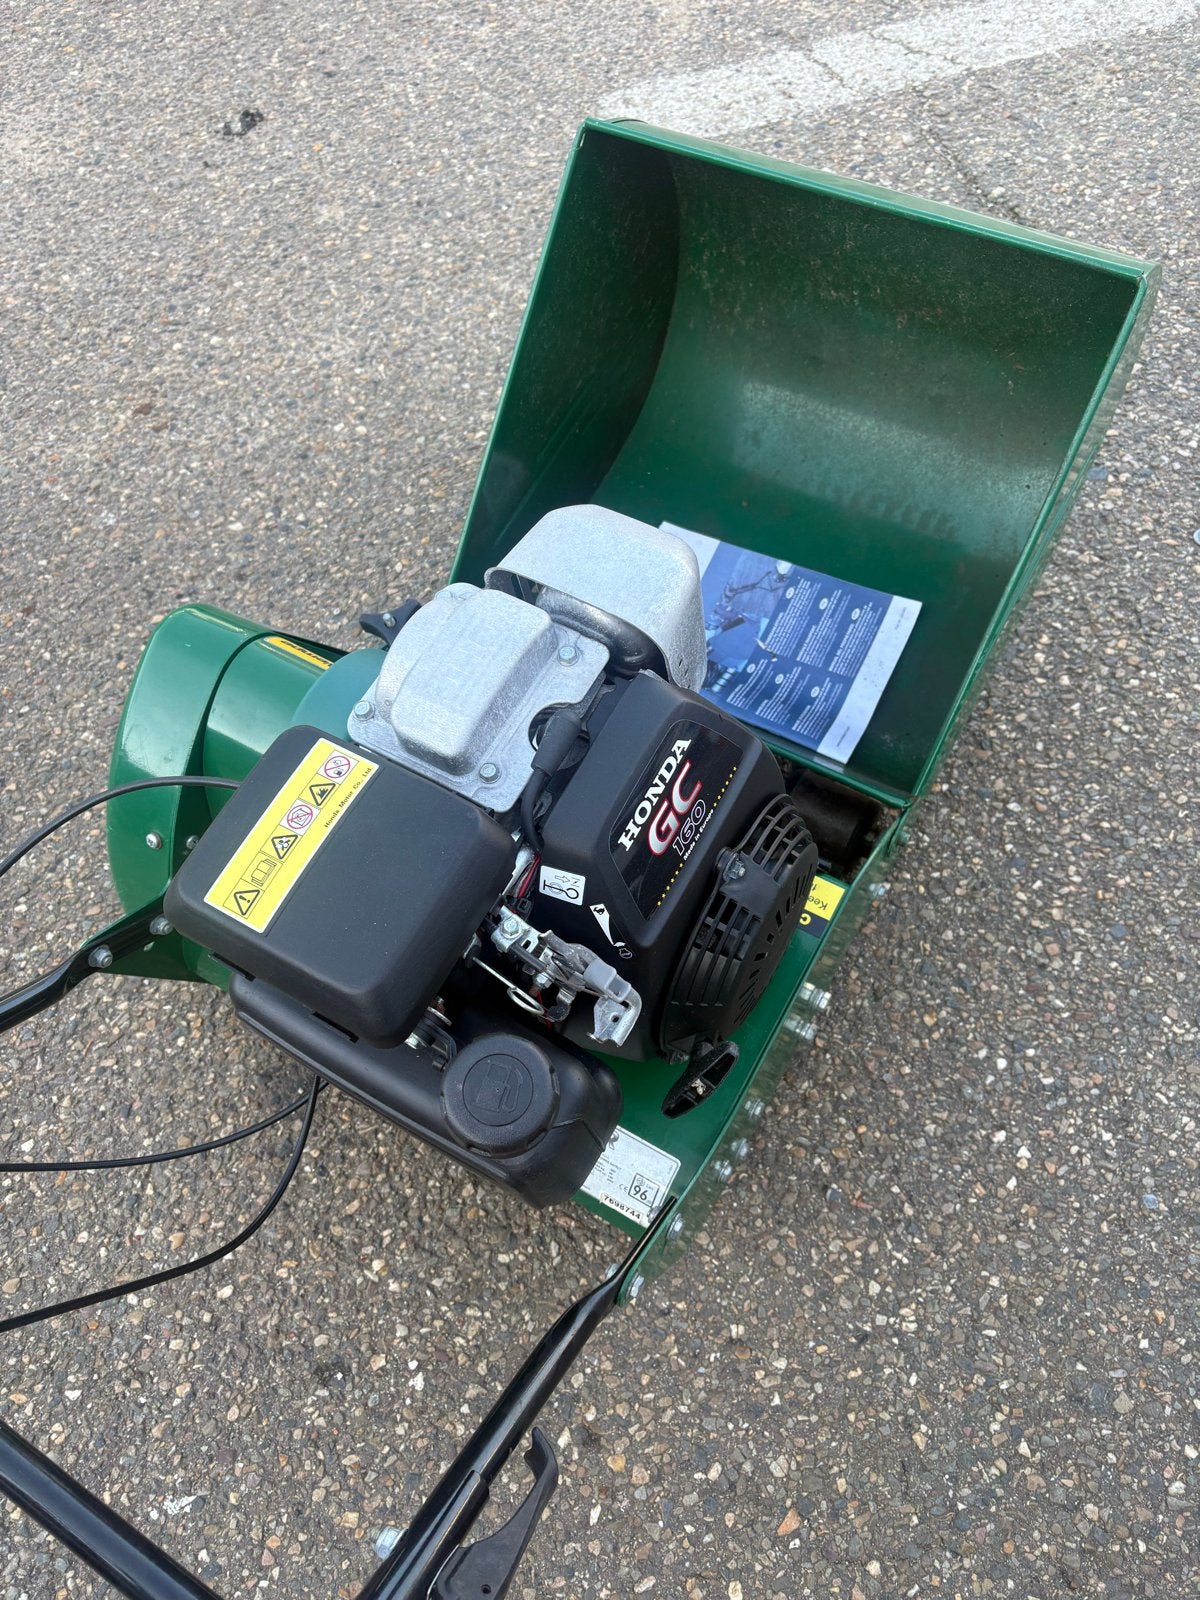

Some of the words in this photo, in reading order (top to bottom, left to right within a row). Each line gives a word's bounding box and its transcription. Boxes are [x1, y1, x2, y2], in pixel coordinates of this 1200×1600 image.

[323, 809, 340, 828] Honda
[338, 791, 353, 808] Motor
[617, 738, 692, 851] HONDA
[648, 759, 702, 857] GC
[672, 799, 706, 856] 160
[683, 841, 696, 861] Made
[694, 833, 700, 841] in
[699, 808, 714, 833] Europe
[633, 1185, 648, 1201] 96
